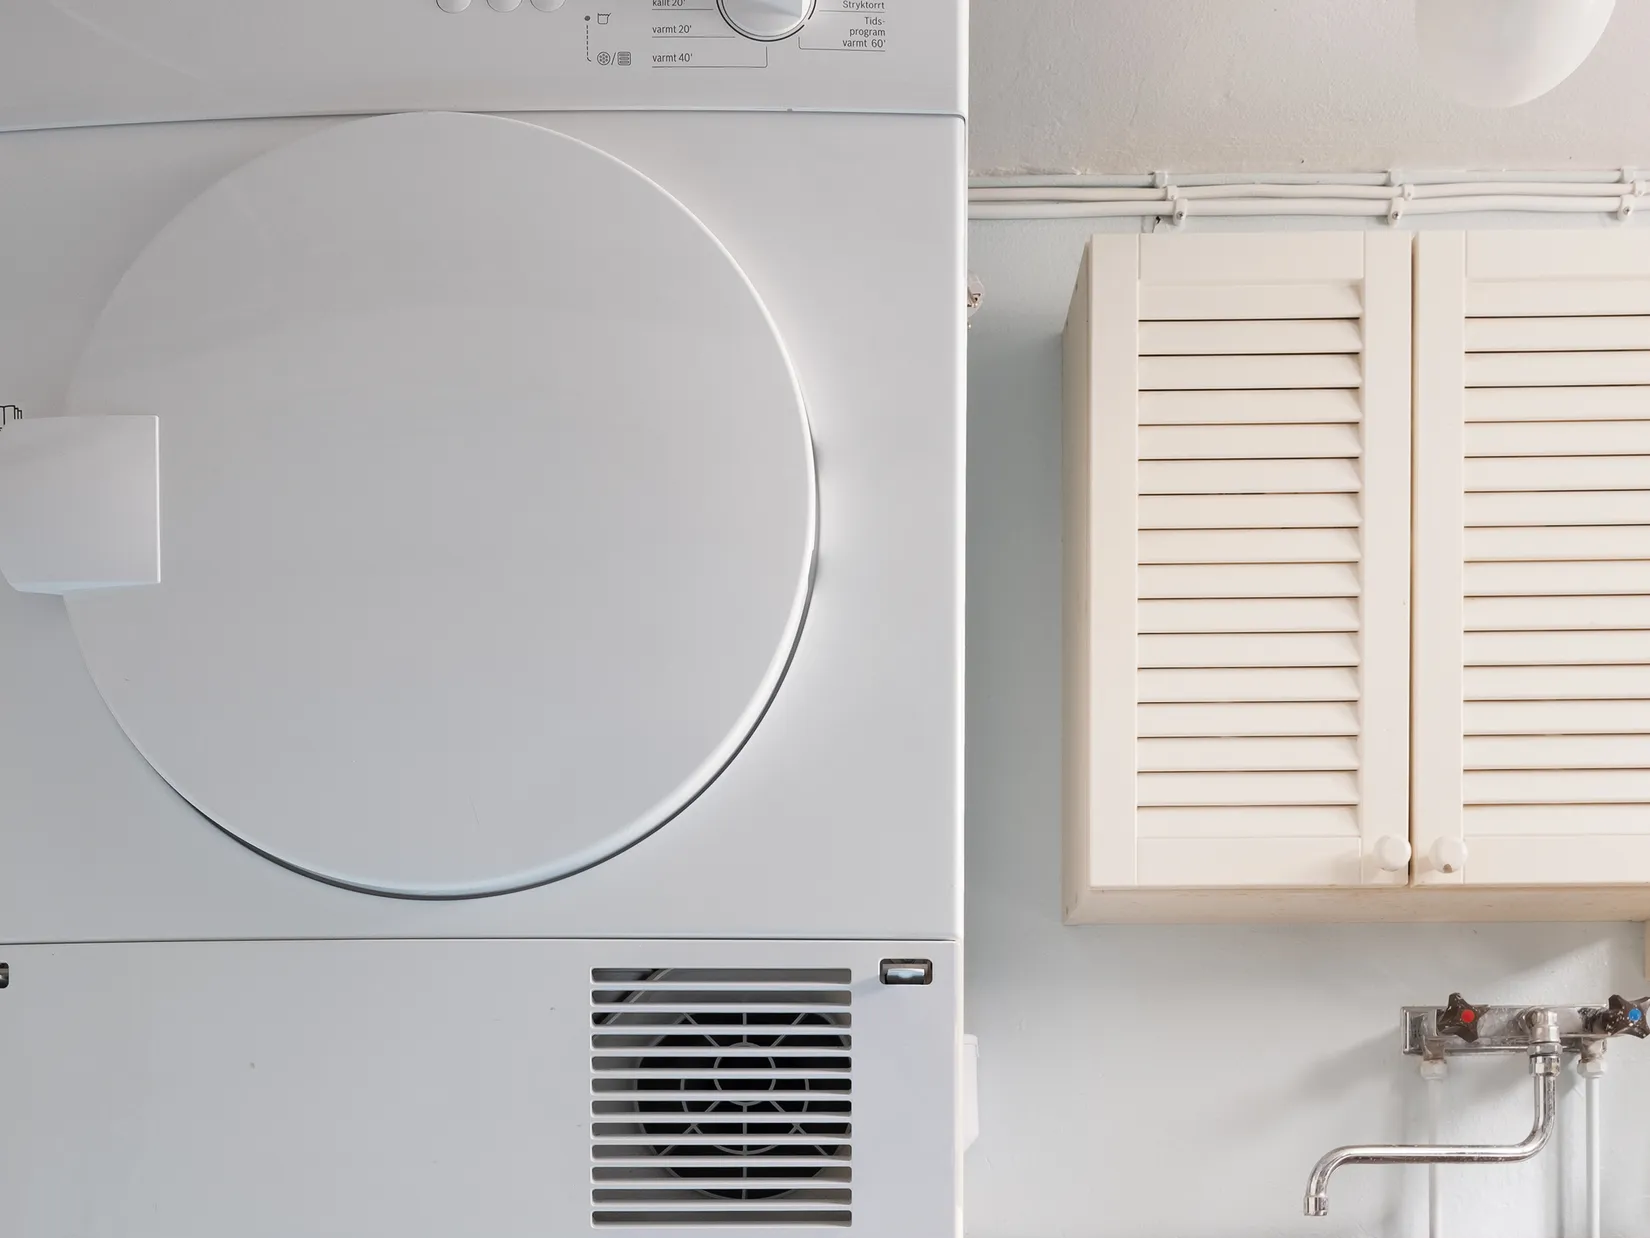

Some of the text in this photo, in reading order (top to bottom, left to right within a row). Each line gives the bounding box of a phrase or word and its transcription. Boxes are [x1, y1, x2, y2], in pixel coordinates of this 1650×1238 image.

[842, 0, 885, 10] Stryktorrt
[864, 17, 886, 26] Tids-
[652, 26, 692, 34] varmt 20'
[849, 28, 886, 37] program
[842, 39, 886, 48] varmt 60'
[652, 54, 693, 62] varmt 40'
